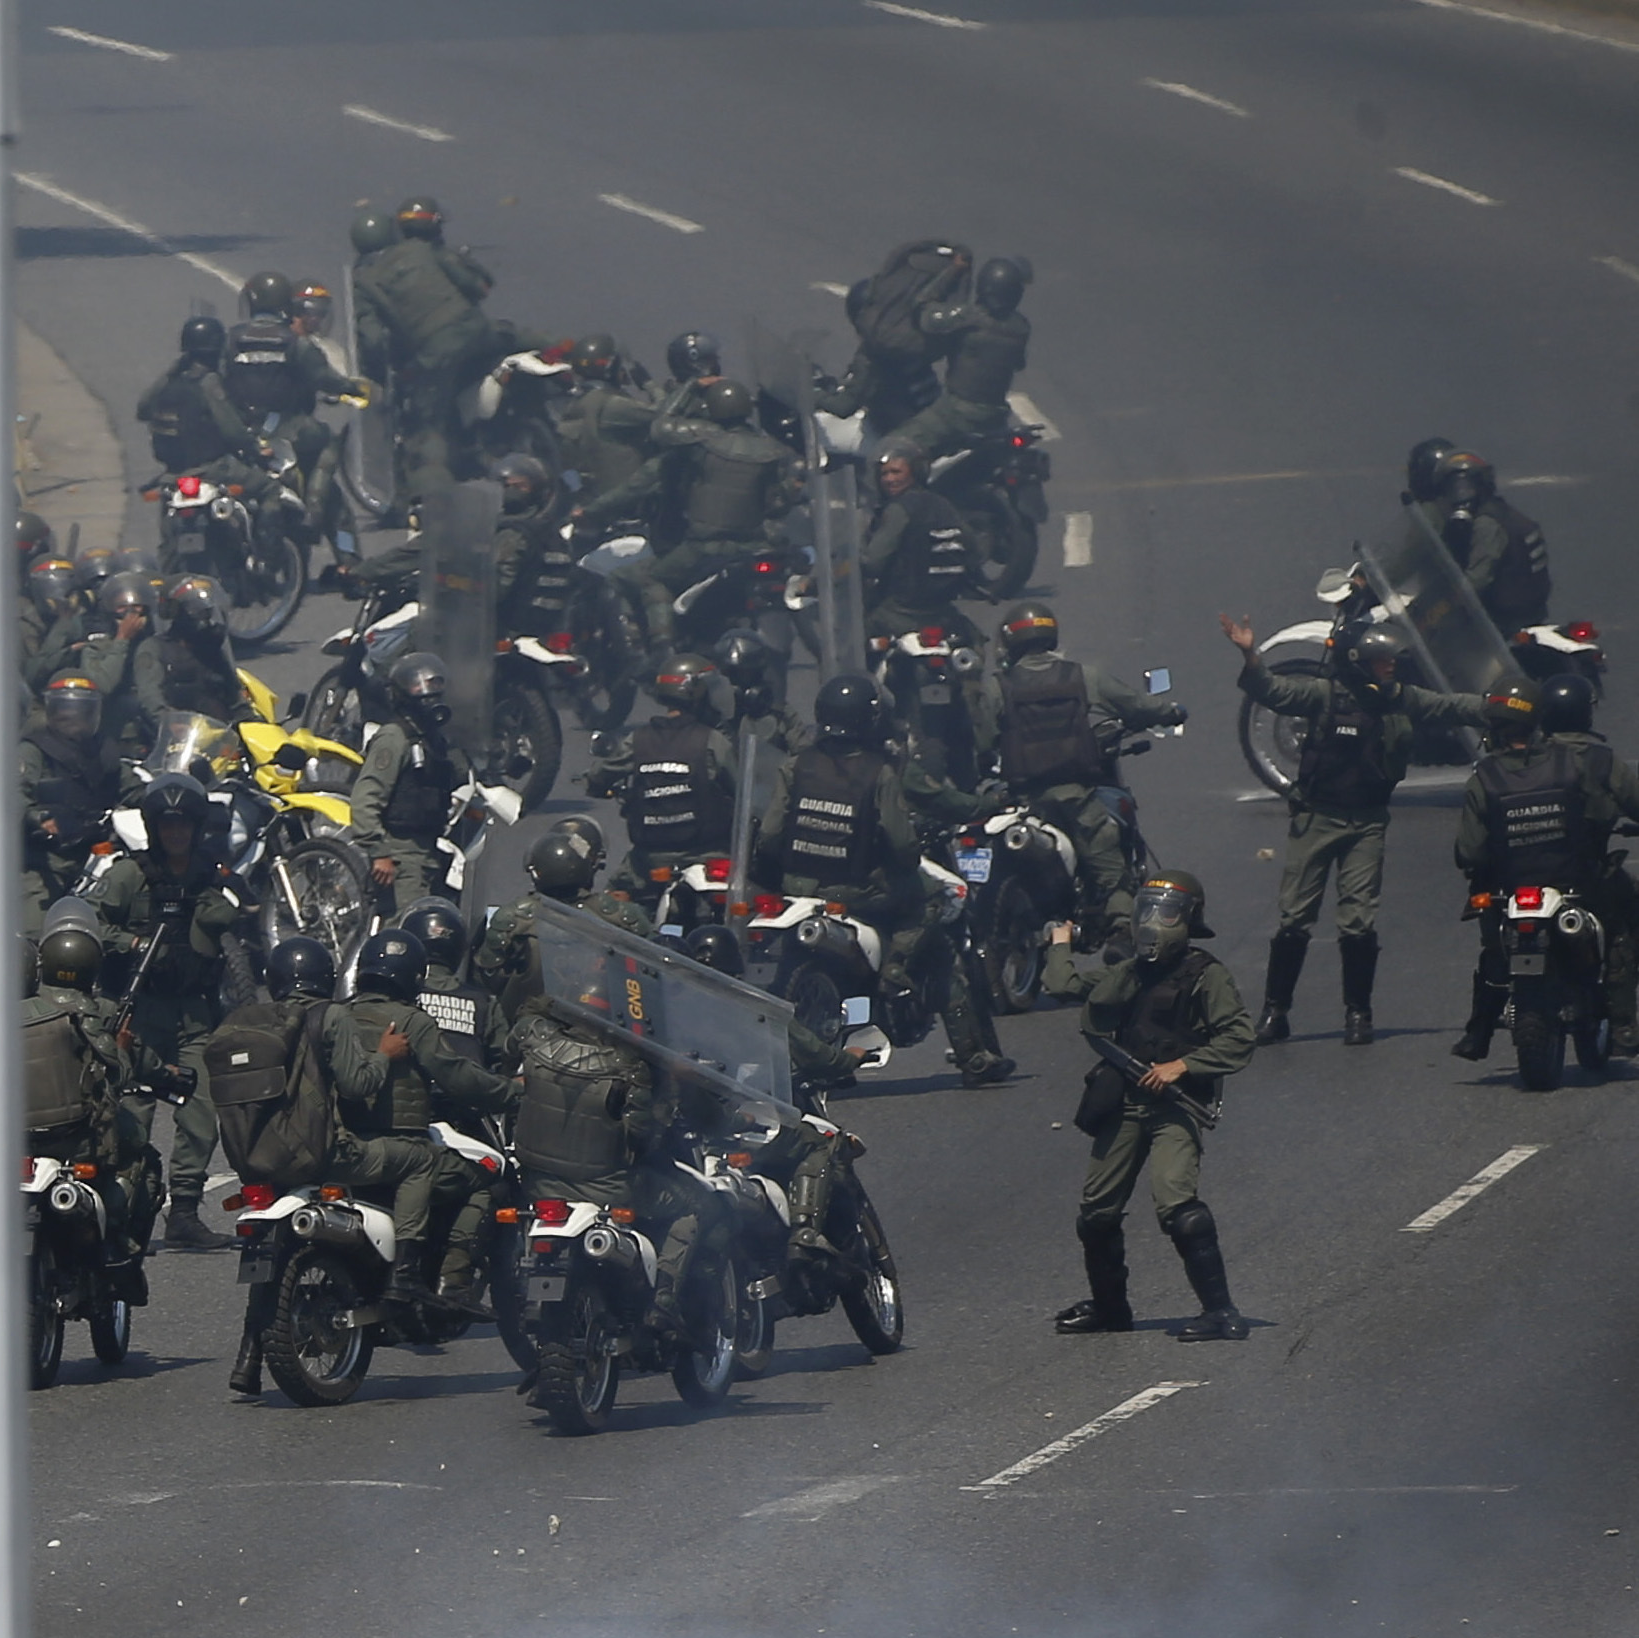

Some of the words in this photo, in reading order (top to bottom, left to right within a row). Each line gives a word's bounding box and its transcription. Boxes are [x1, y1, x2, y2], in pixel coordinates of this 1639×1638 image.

[799, 797, 853, 817] GUARDIA
[1506, 803, 1562, 818] GUARDIA
[416, 992, 476, 1012] UARDIA
[626, 978, 643, 1020] GNB
[421, 1004, 476, 1025] CIONAL
[436, 1017, 475, 1035] ARIANA
